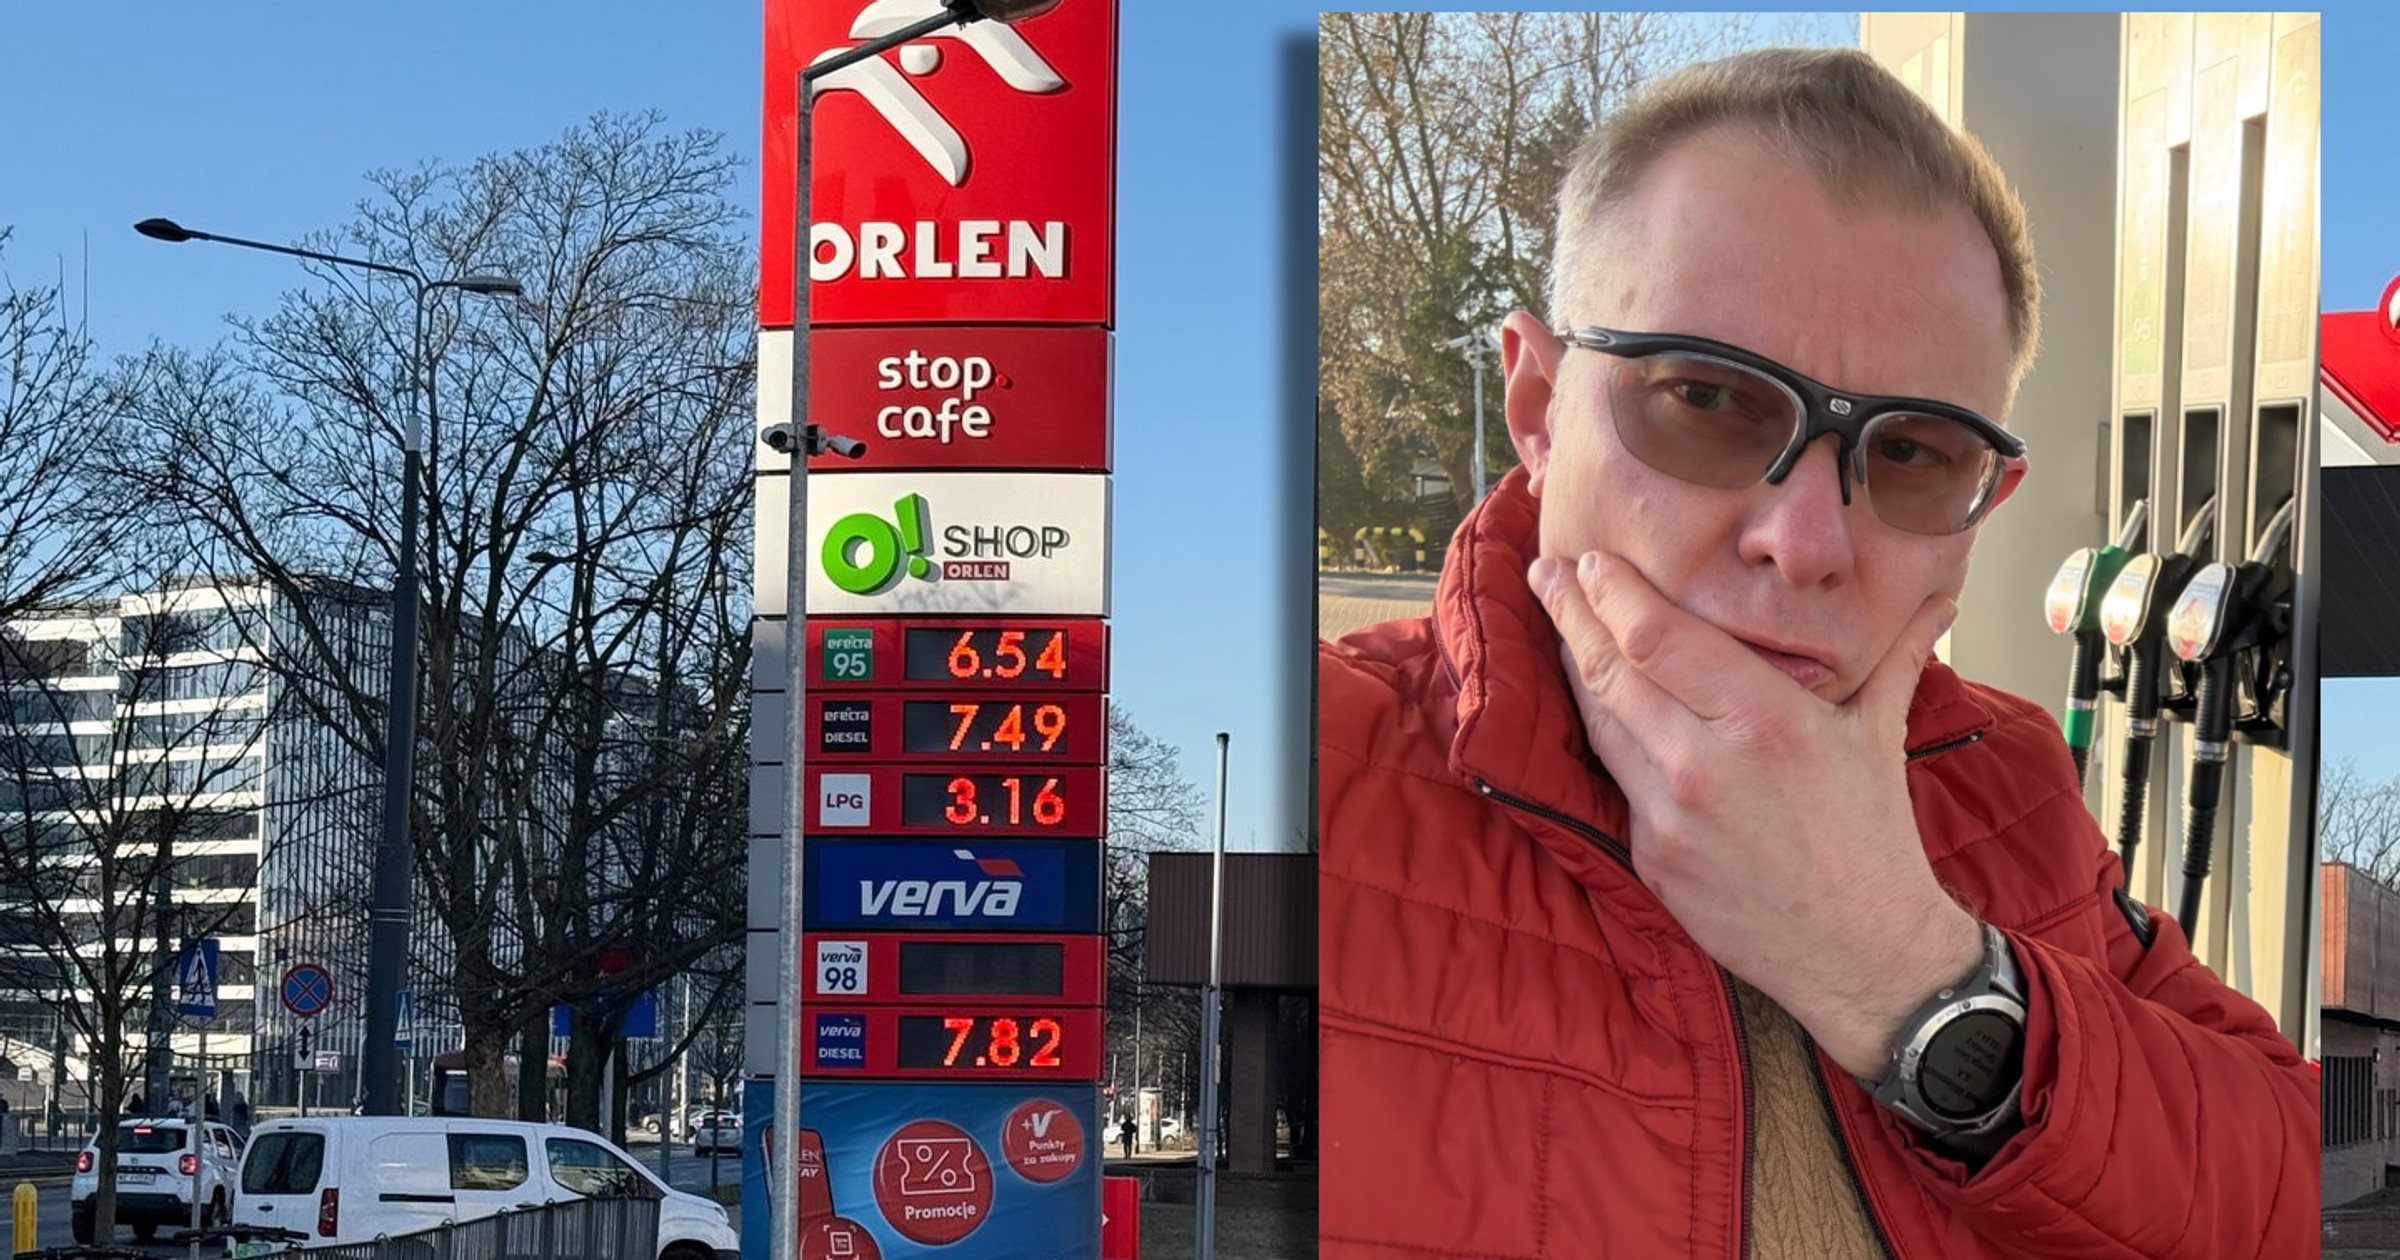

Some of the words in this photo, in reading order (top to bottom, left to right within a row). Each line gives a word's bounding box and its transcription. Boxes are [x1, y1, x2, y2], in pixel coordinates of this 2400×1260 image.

[809, 221, 1064, 282] ORLEN
[2133, 317, 2151, 341] 95
[878, 350, 992, 401] stop
[877, 398, 992, 444] cafe
[943, 525, 1068, 558] SHOP
[948, 564, 1008, 579] ORLEN
[833, 653, 867, 677] 95
[948, 631, 1067, 679] 6.54
[825, 732, 869, 743] DIESEL
[949, 705, 1067, 751] 7.49
[826, 793, 863, 810] LPG
[945, 778, 1065, 825] 3.16
[860, 880, 1023, 917] verva
[821, 952, 862, 963] verva
[825, 967, 857, 991] 98
[819, 1025, 862, 1037] verva
[943, 1018, 1061, 1067] 7.82
[818, 1047, 863, 1060] DIESEL
[1029, 1140, 1066, 1151] Punkty
[1023, 1156, 1037, 1165] za
[1040, 1152, 1076, 1164] zakupy
[904, 1202, 977, 1220] Promocje
